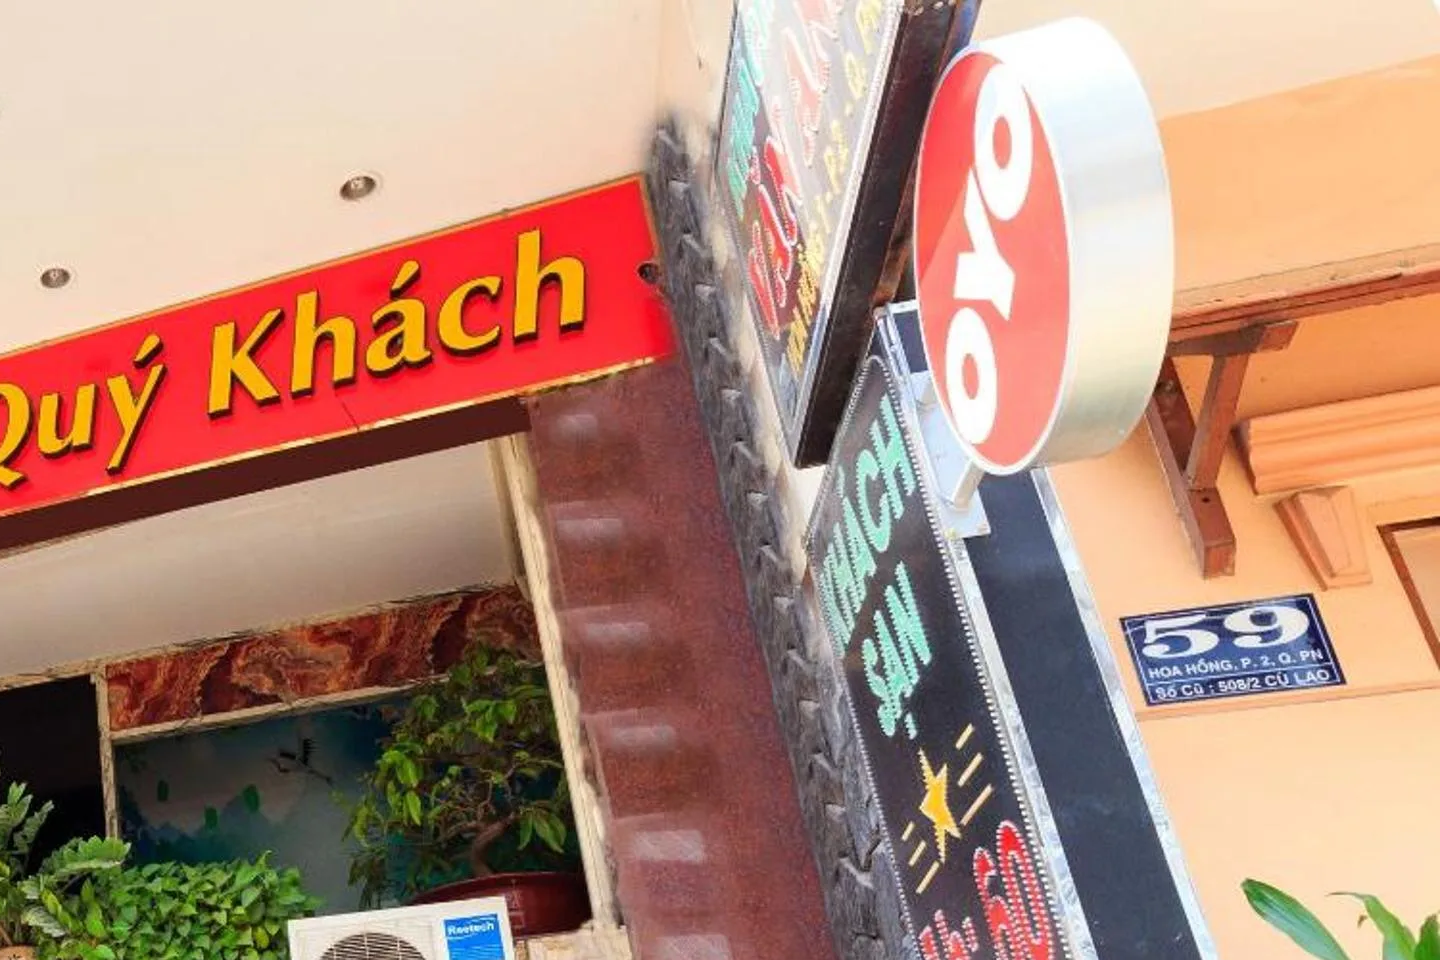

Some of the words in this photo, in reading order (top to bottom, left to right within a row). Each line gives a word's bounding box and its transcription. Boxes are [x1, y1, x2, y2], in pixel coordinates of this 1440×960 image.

[946, 62, 1034, 445] OYO
[210, 231, 585, 414] Khách
[862, 560, 933, 740] SẠN
[1142, 605, 1310, 659] 59
[1148, 665, 1183, 679] HOA
[1299, 649, 1324, 662] PN
[1218, 677, 1261, 693] 508/2
[1294, 668, 1331, 684] LAO
